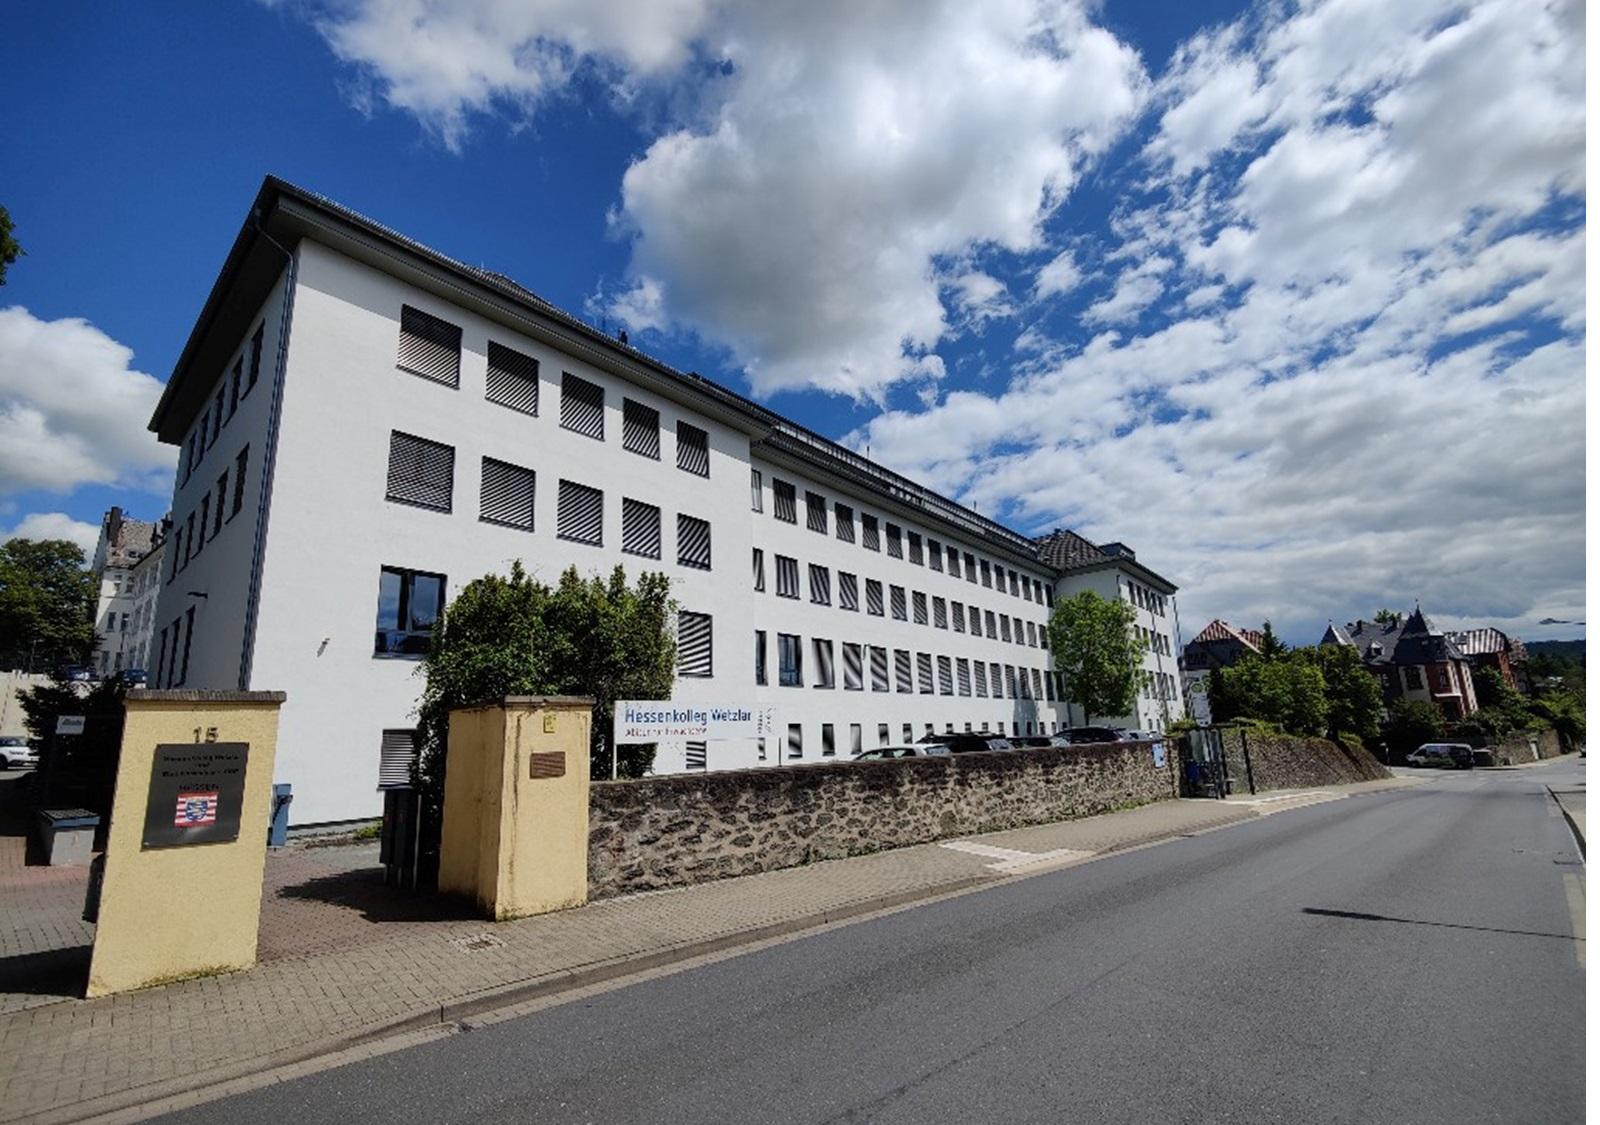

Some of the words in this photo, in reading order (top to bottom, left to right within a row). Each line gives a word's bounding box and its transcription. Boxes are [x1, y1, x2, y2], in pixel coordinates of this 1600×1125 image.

[625, 709, 707, 726] Hessenkolleg
[710, 708, 751, 721] Wetzlar
[193, 726, 219, 743] 15
